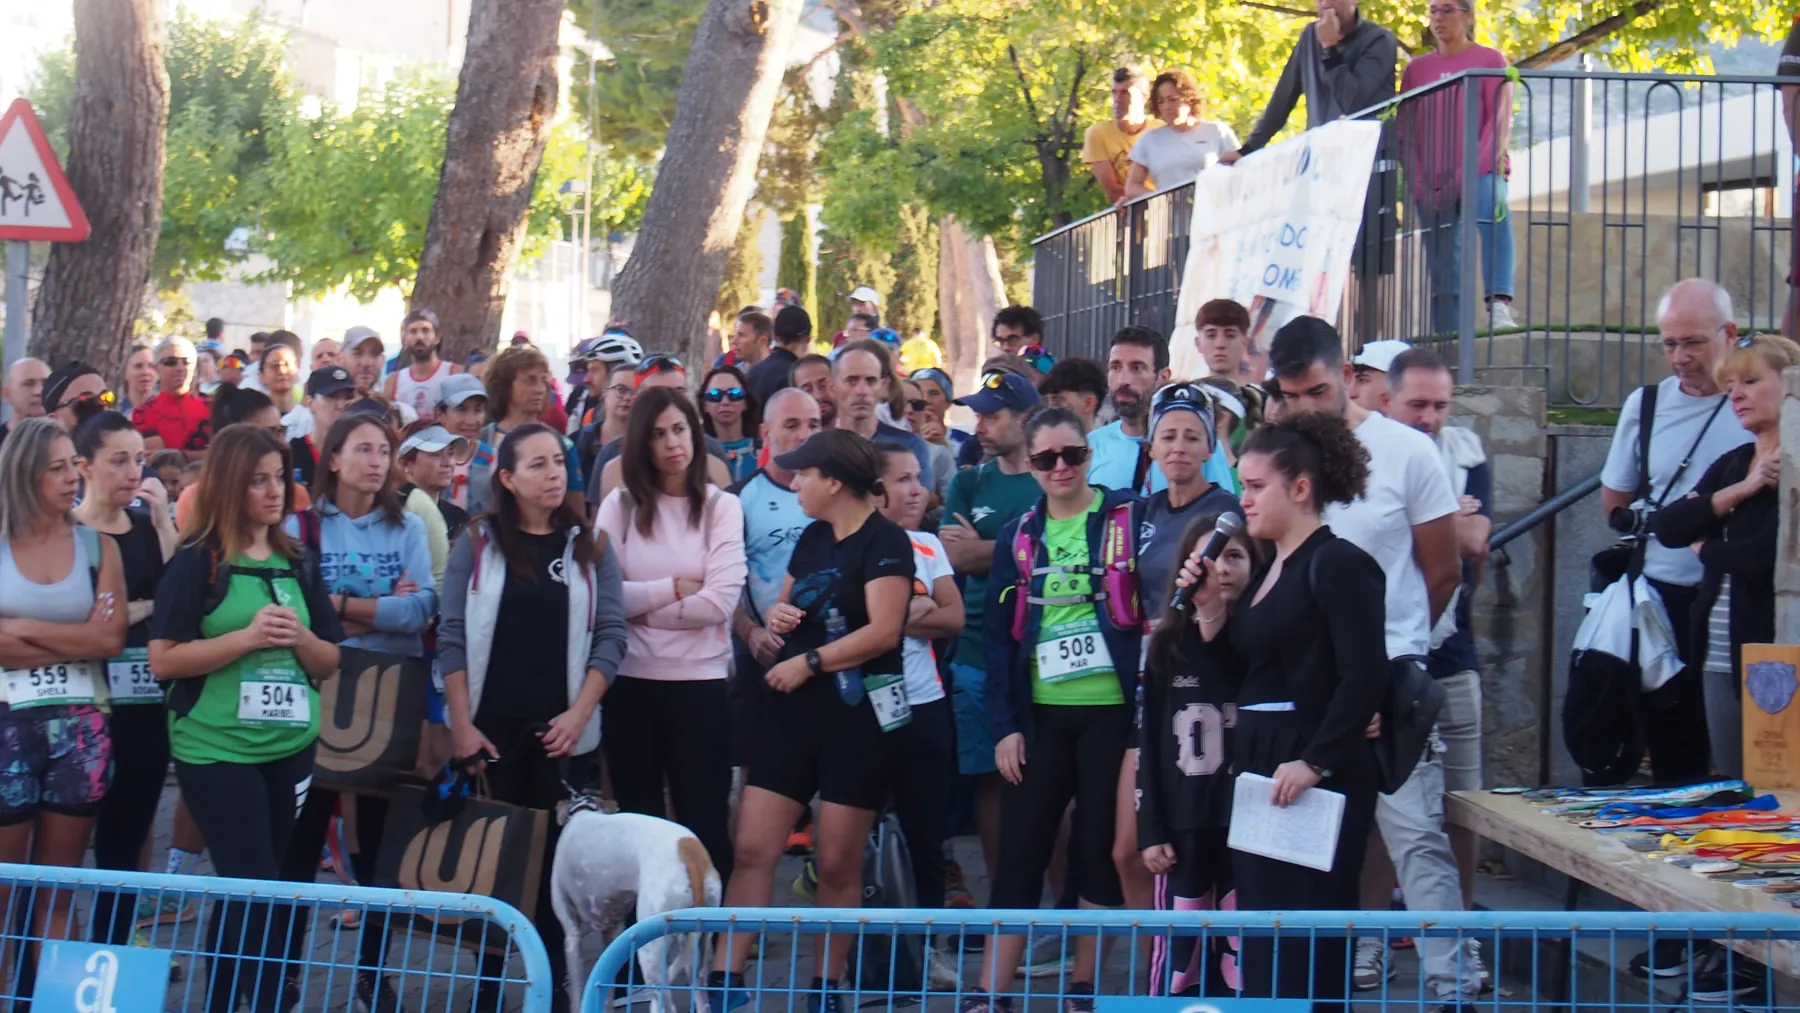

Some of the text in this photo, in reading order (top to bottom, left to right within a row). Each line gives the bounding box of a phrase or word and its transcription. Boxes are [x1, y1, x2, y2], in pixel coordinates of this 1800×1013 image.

[1059, 635, 1095, 660] 508
[1070, 659, 1089, 669] MAR
[29, 665, 69, 686] 559
[36, 687, 68, 697] SHEILA
[261, 685, 294, 706] 504
